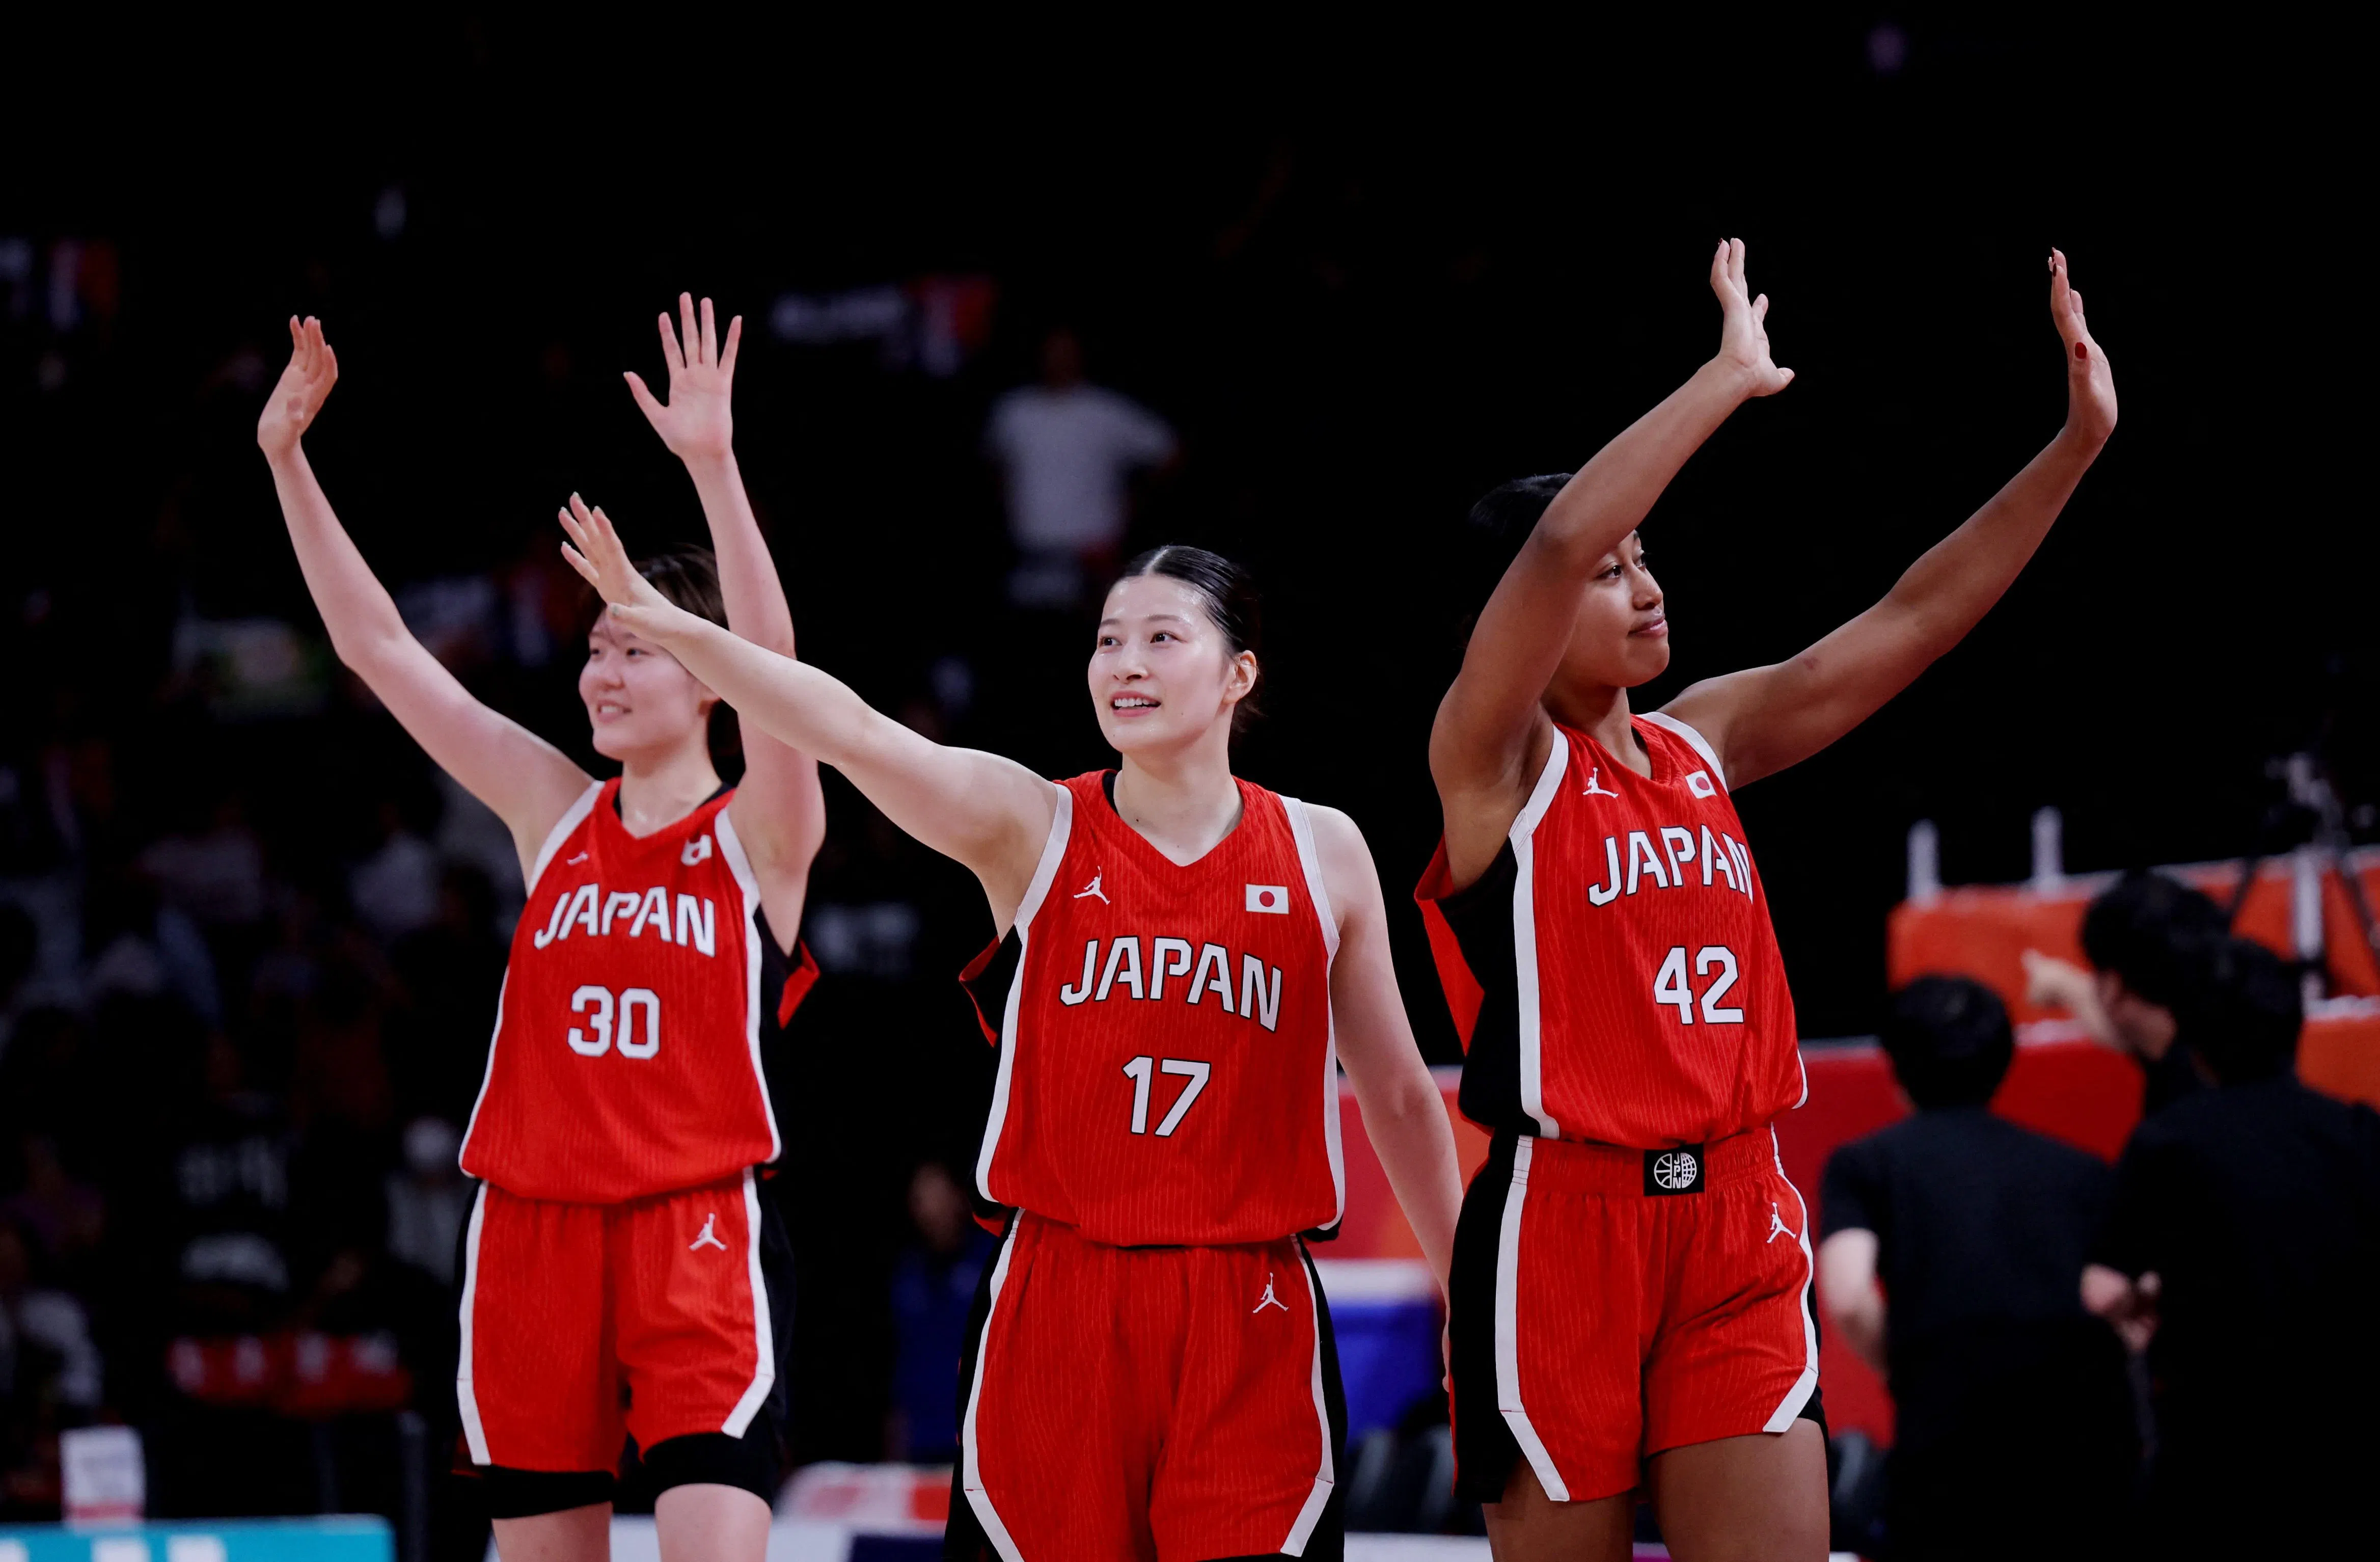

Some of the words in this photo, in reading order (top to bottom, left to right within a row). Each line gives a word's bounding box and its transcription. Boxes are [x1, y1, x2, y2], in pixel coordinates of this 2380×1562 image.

[1588, 824, 1753, 906] JAPAN
[534, 883, 715, 957] JAPAN
[567, 985, 660, 1060] 30
[1060, 936, 1282, 1033] JAPAN
[1653, 946, 1744, 1025] 42
[1122, 1056, 1211, 1137] 17
[1673, 1153, 1682, 1189] JPN
